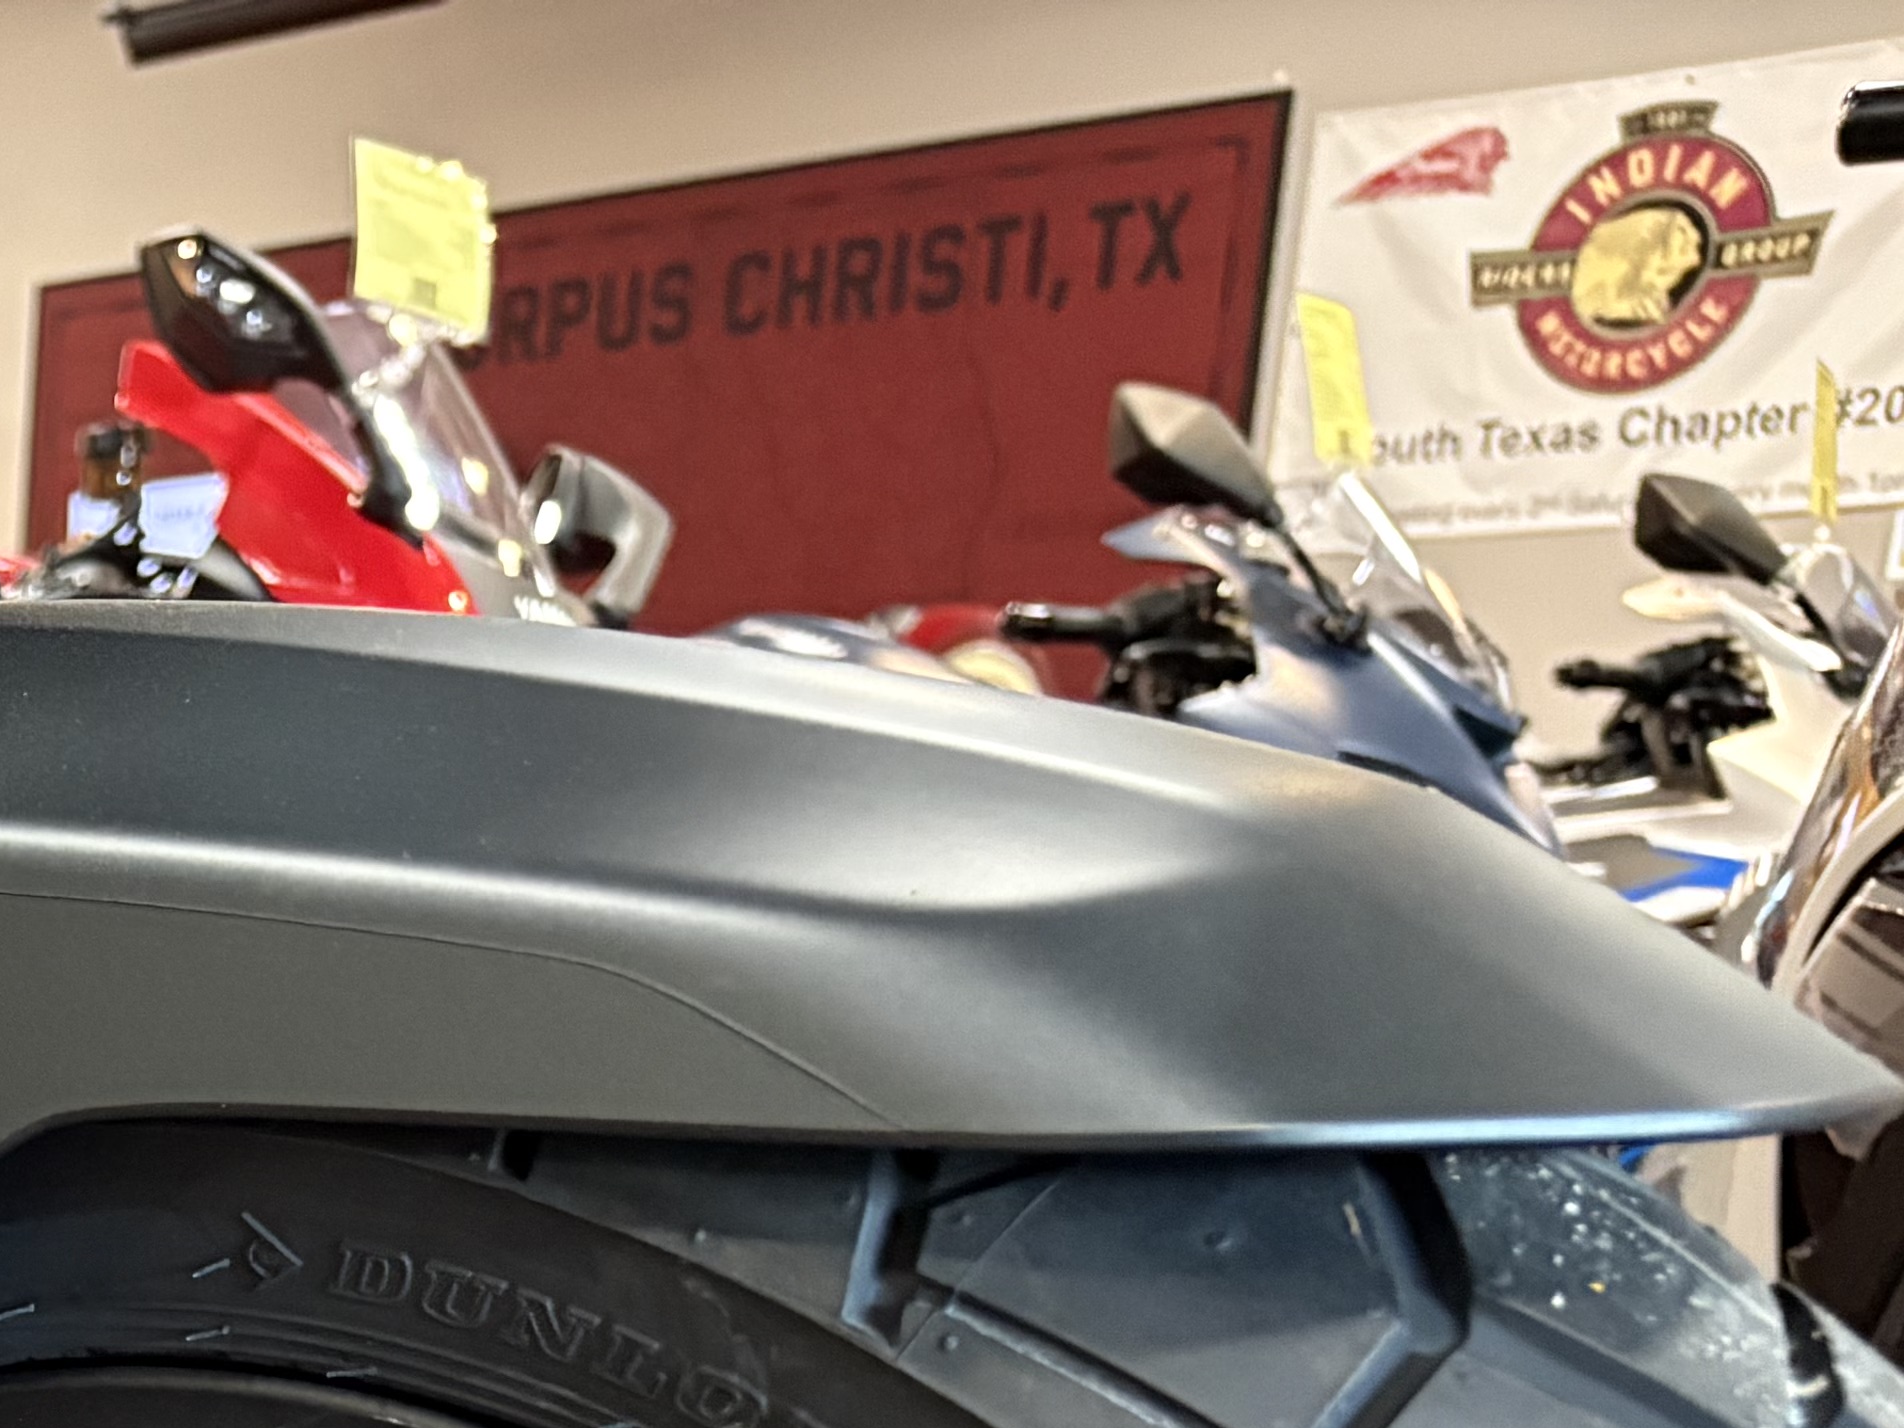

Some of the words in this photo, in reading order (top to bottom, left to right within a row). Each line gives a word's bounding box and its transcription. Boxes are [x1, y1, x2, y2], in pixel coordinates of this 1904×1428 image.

[1565, 144, 1752, 225] INDIAN
[456, 258, 694, 370] RPUS
[724, 213, 1068, 336] CHRISTI,
[1090, 192, 1191, 292] TX
[1720, 233, 1813, 270] GROUP
[1534, 293, 1732, 382] MOTORCYCLE
[1374, 423, 1461, 466] outh
[1478, 416, 1600, 459] Texas
[1619, 401, 1810, 450] Chapter
